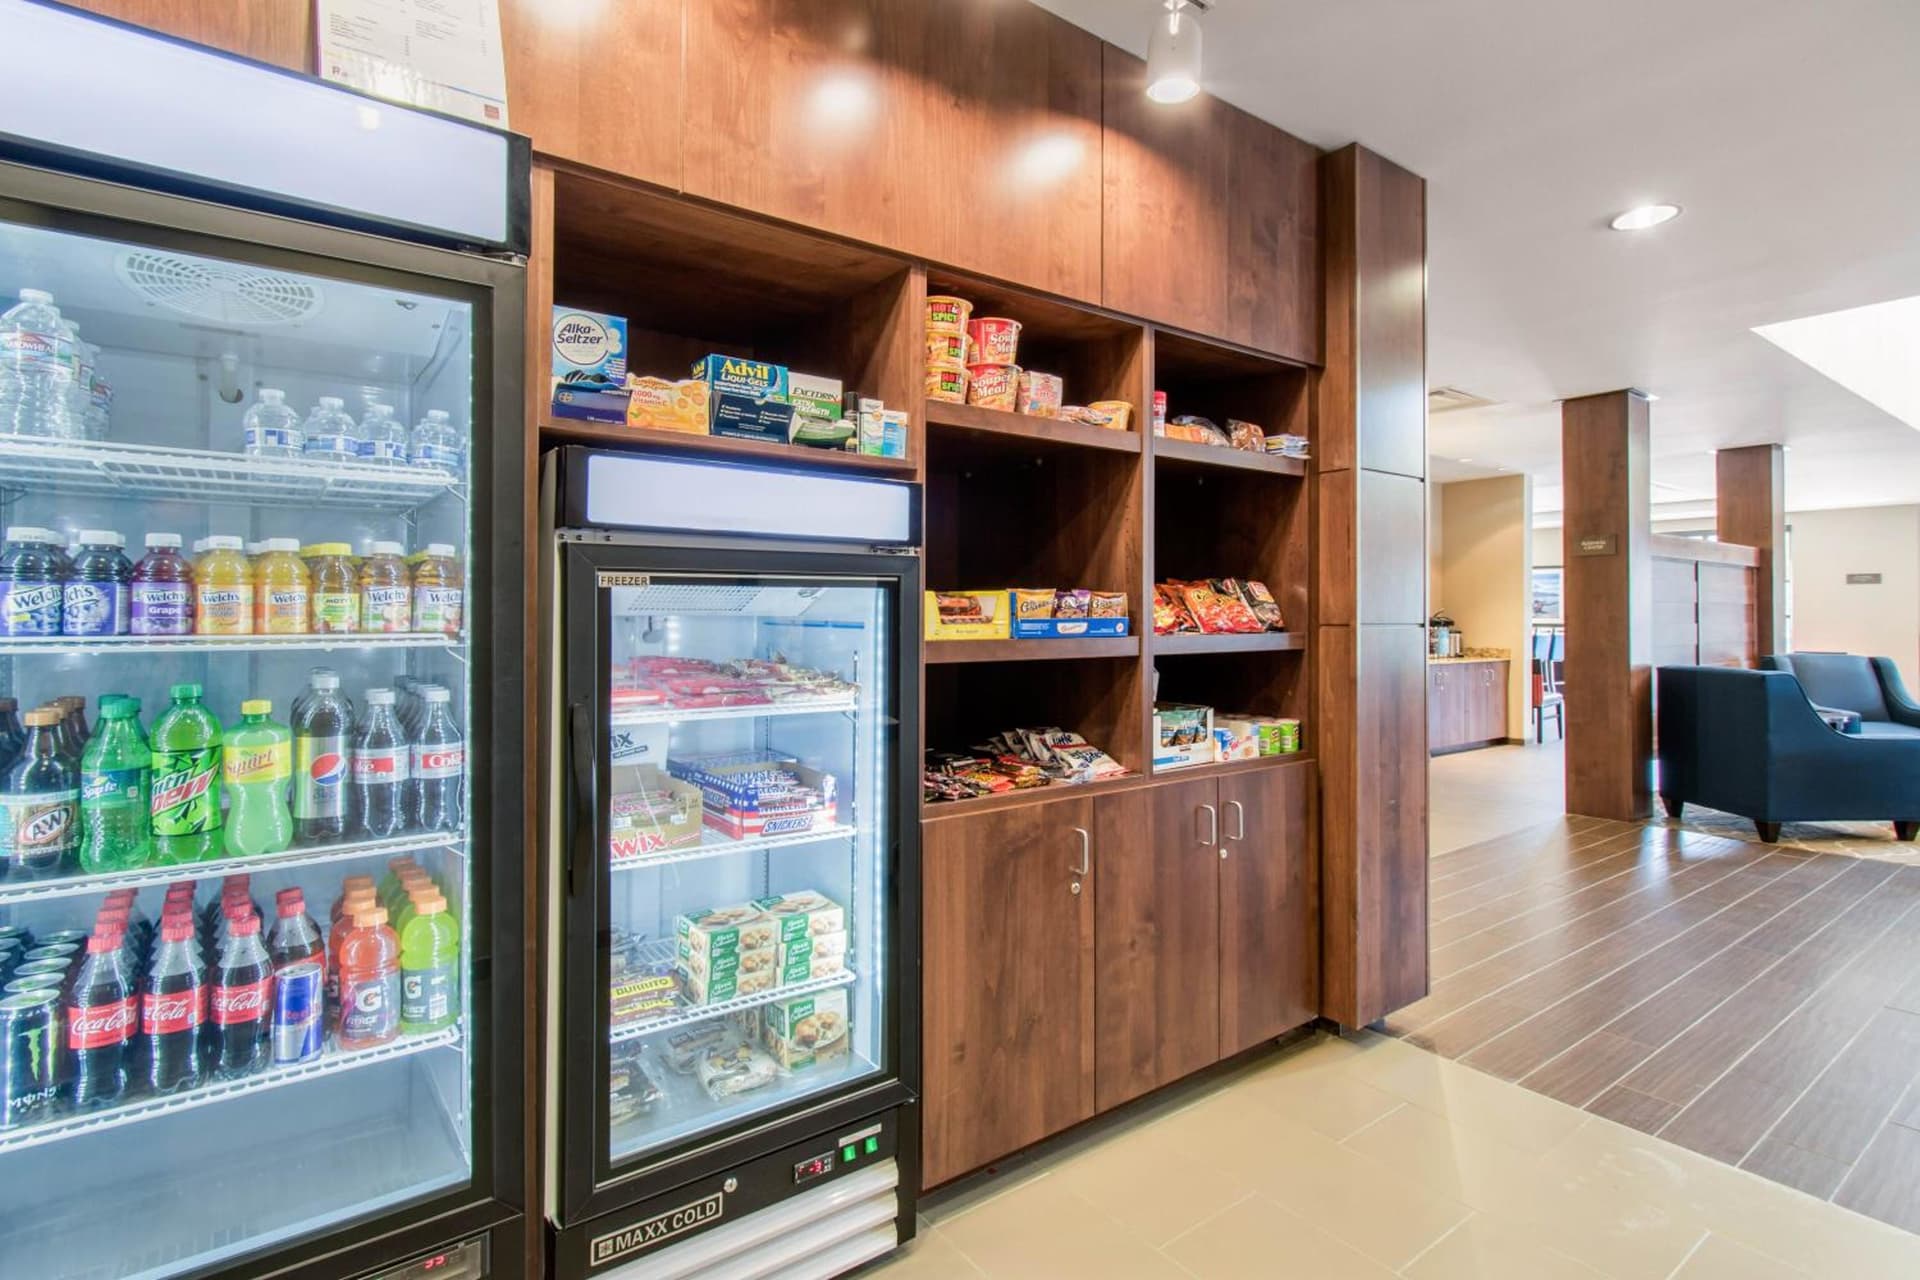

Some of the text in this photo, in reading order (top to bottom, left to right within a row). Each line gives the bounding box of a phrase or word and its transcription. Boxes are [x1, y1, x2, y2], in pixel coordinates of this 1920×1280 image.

[561, 322, 596, 334] Alka-
[557, 333, 603, 345] Seltzer
[721, 359, 768, 379] Advil
[601, 575, 648, 586] FREEZER
[149, 606, 182, 616] Grape
[82, 783, 117, 799] Sprite
[765, 816, 811, 832] SNICKERS
[616, 1199, 716, 1253] MAXX COLD
